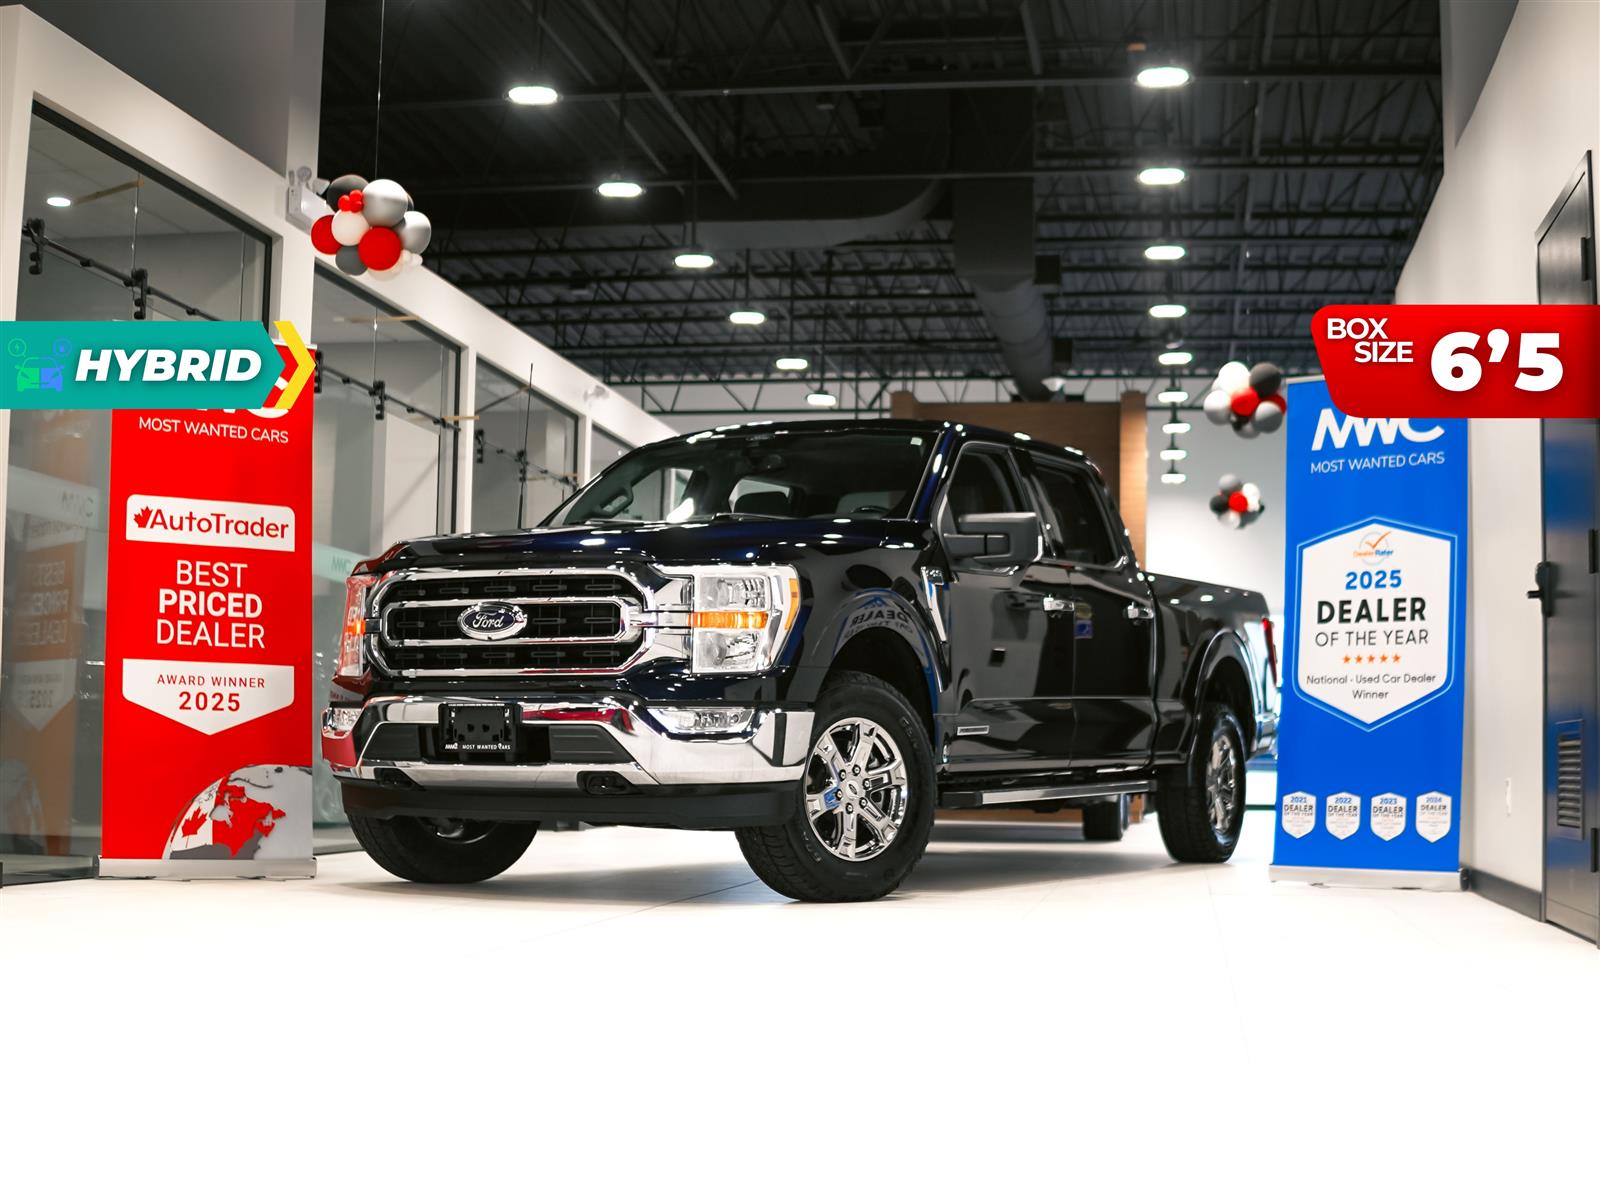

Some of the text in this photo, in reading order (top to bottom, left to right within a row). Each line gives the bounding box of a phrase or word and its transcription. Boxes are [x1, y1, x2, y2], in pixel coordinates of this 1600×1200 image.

[139, 416, 289, 443] MOST WANTED CARS
[1310, 452, 1445, 474] MOST WANTED CARS
[149, 508, 289, 539] AutoTrader
[176, 559, 248, 588] BEST
[1345, 569, 1402, 590] 2025
[159, 588, 263, 618] PRICED
[1316, 597, 1426, 624] DEALER
[472, 611, 504, 628] Ford
[157, 618, 265, 649] DEALER
[1315, 629, 1429, 647] OF THE YEAR
[157, 673, 266, 689] AWARD WINNER
[1306, 674, 1348, 685] National
[1355, 674, 1380, 684] Used
[1382, 674, 1401, 684] Car
[1403, 673, 1436, 684] Dealer
[178, 691, 241, 712] 2025
[1352, 689, 1389, 700] Winner
[1284, 804, 1313, 812] DEALER
[1328, 805, 1358, 813] DEALER
[1372, 806, 1403, 814] DEALER
